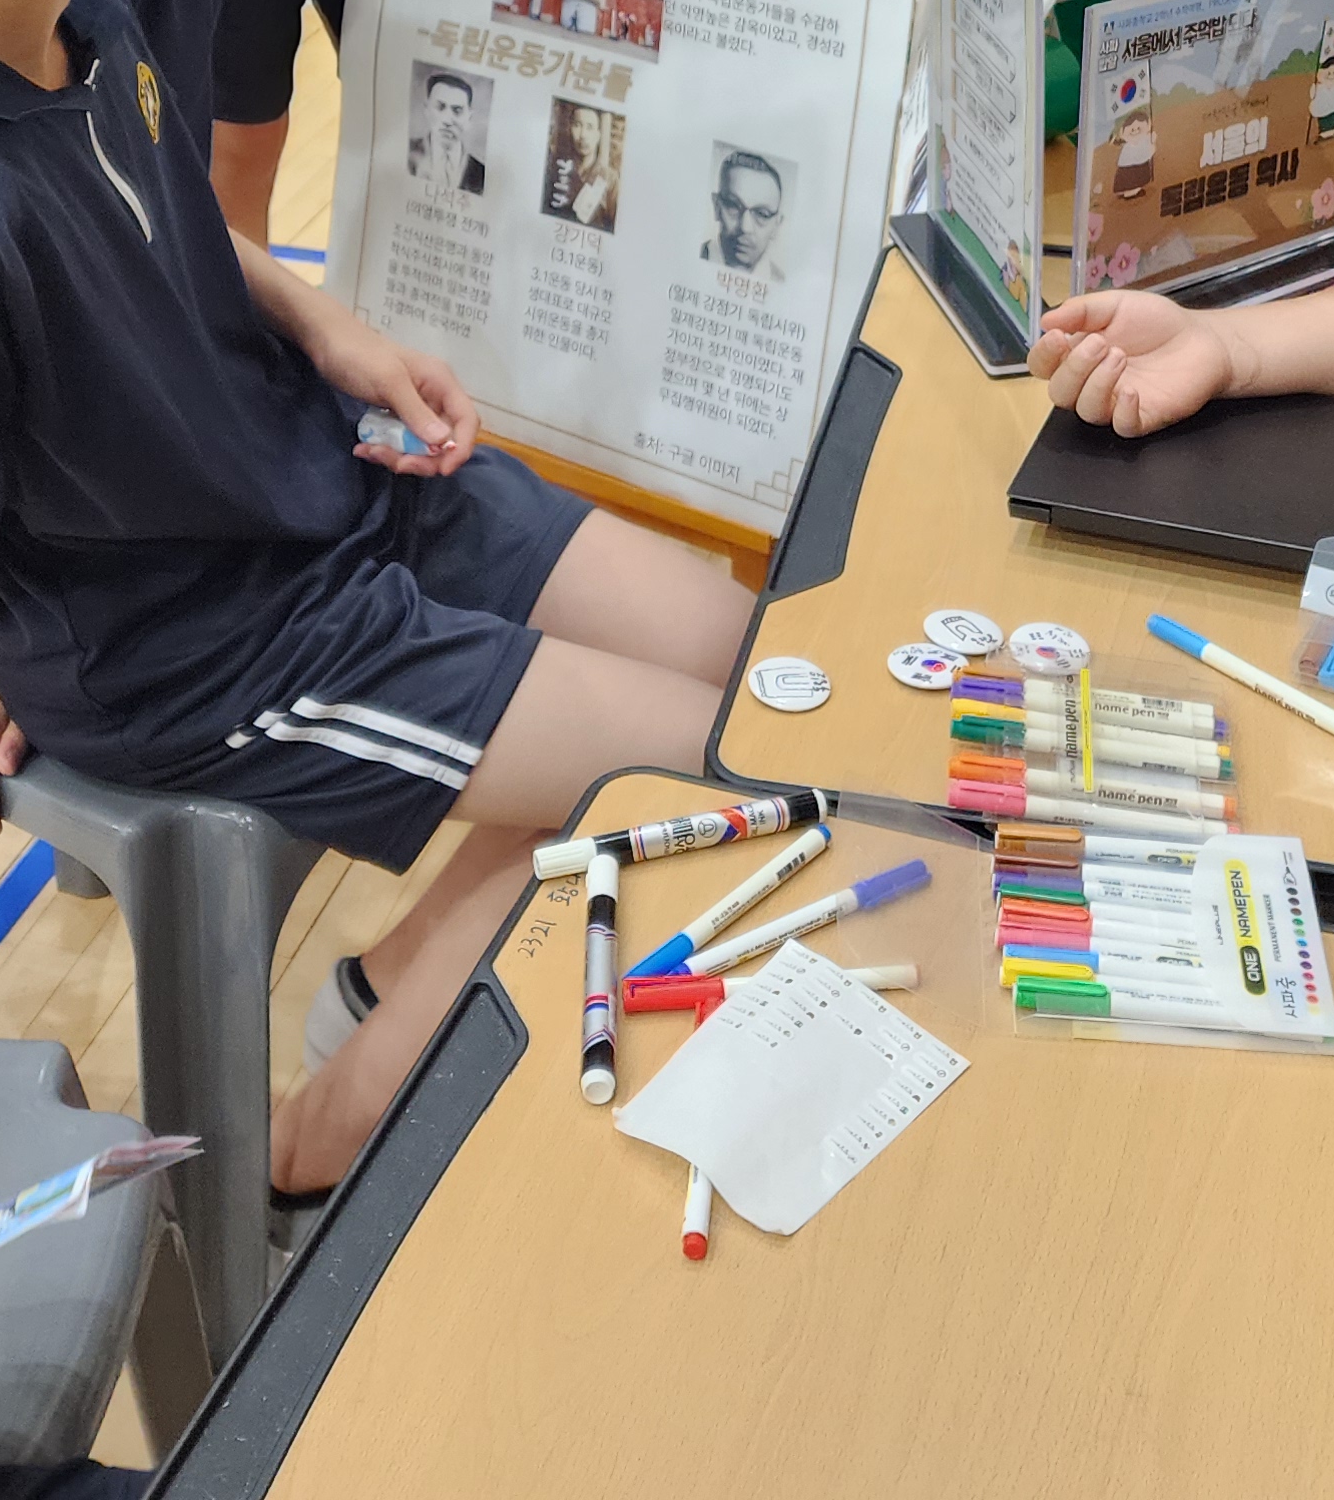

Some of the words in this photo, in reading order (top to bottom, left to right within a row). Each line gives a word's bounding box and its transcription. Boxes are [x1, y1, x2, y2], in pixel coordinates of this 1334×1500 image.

[663, 19, 712, 44] 옥이라고
[680, 3, 730, 28] 악명높은
[734, 15, 801, 49] 감옥이었고,
[807, 34, 845, 58] 경성감
[801, 13, 839, 35] 수감하
[418, 20, 633, 102] -독립운동가분들
[1121, 26, 1182, 64] 서울에서
[1200, 116, 1268, 168] 서울의
[1159, 161, 1250, 217] 독립운동
[1256, 147, 1299, 187] 역사
[554, 222, 602, 254] 강기덕
[550, 247, 603, 277] (3.1운동)
[531, 267, 571, 291] 3.1운동
[575, 280, 597, 300] 당시
[602, 289, 613, 305] 학
[525, 306, 582, 335] 시위운동을
[528, 286, 573, 311] 생대표로
[577, 302, 612, 324] 대규모
[703, 296, 742, 320] 강점기
[748, 308, 806, 342] 독립시위)
[548, 333, 597, 361] 인물이다.
[667, 328, 704, 350] 가이자
[707, 341, 786, 379] 정치인이었다.
[735, 329, 748, 344] 때
[752, 333, 803, 363] 독립운동
[730, 369, 793, 401] 임명되기도
[734, 391, 771, 416] 뒤에는
[736, 414, 776, 439] 되었다.
[667, 444, 694, 465] 구글
[699, 456, 740, 484] 이미지
[1065, 700, 1079, 722] pen
[1132, 707, 1155, 719] pen
[1138, 793, 1164, 808] pen
[1229, 870, 1253, 938] NAMEPEN
[518, 920, 557, 958] 2321
[1267, 920, 1283, 962] PERMANENT
[1243, 948, 1262, 983] ONE
[1275, 977, 1298, 1018] 사파중
